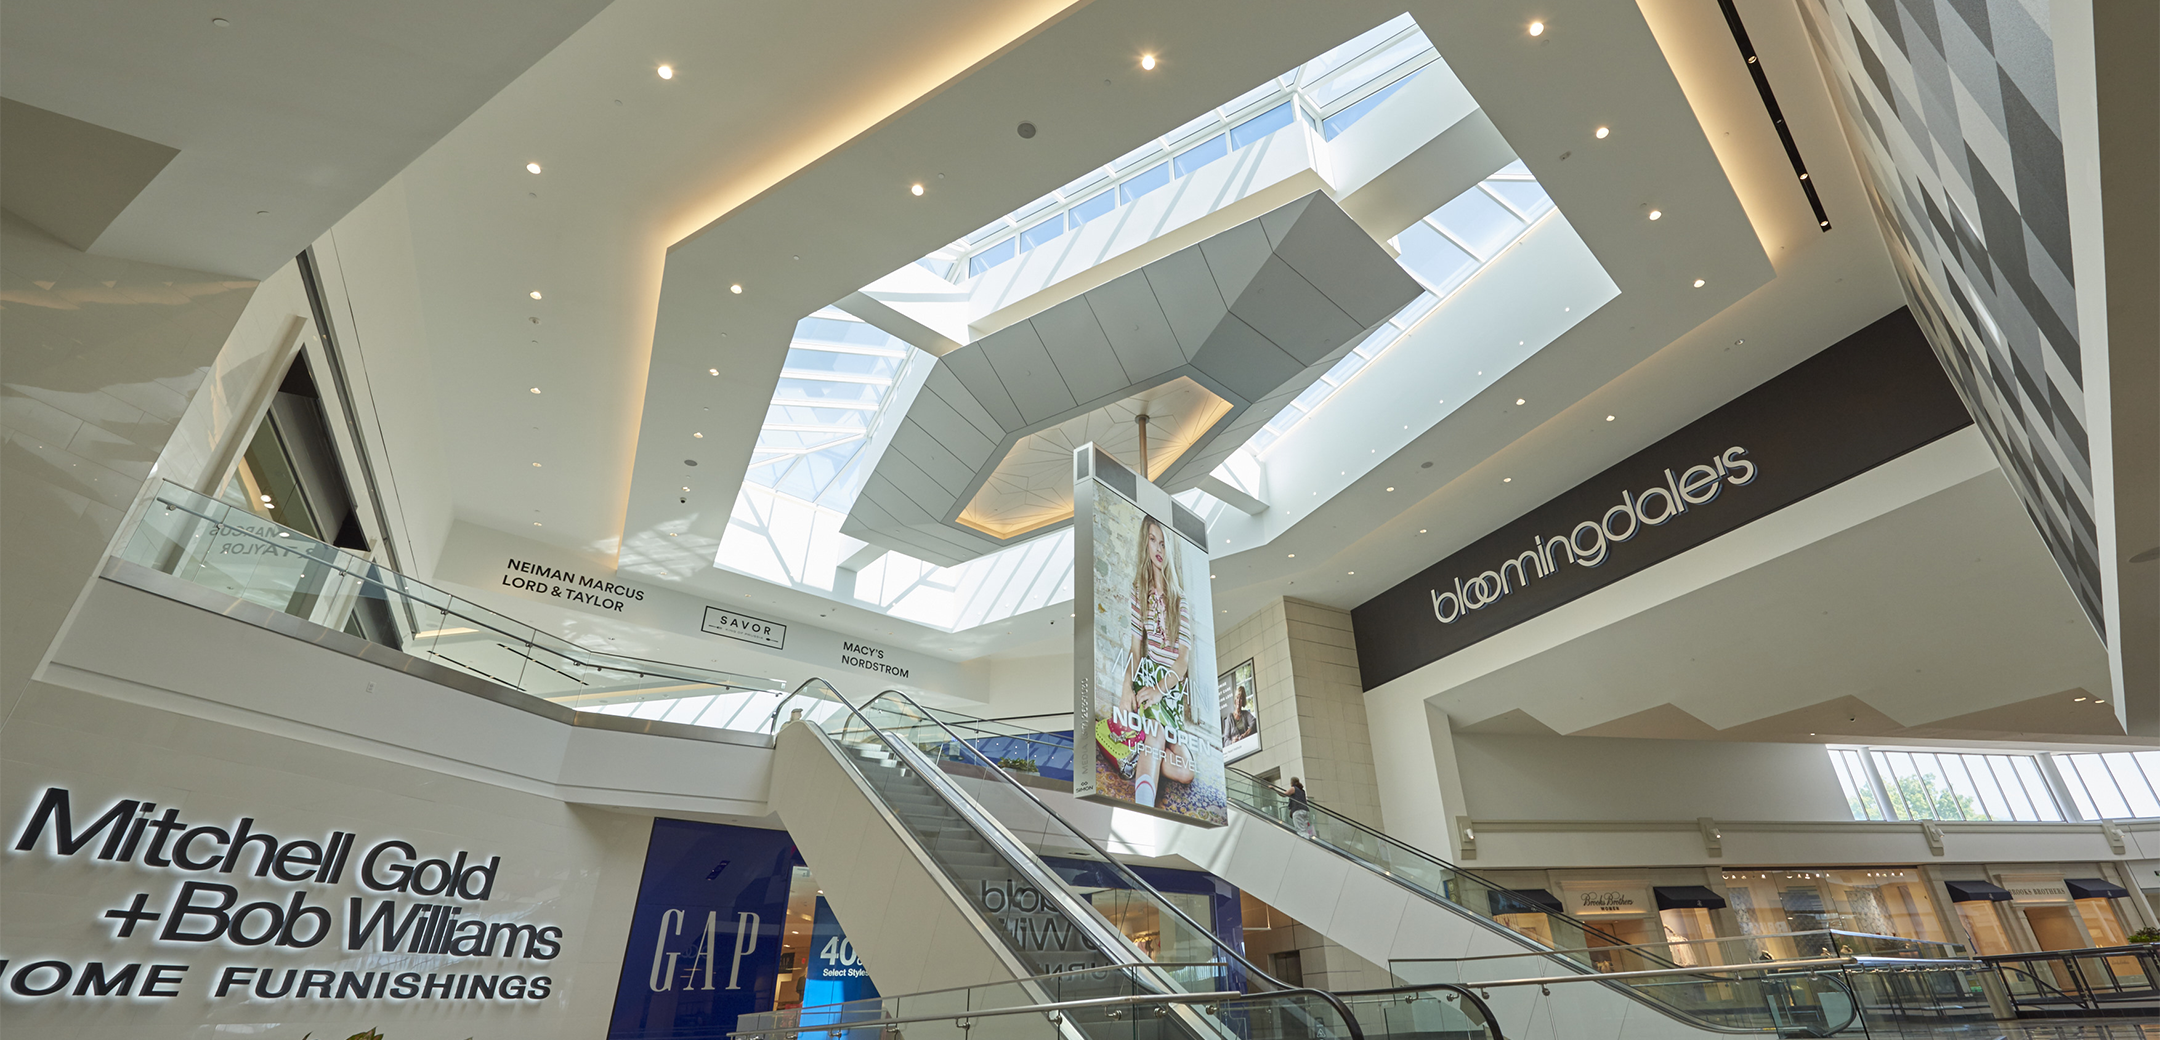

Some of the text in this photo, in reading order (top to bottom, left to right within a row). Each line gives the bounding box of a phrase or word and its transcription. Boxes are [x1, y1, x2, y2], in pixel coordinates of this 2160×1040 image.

[502, 574, 624, 612] LORD & TAYLOR
[507, 558, 645, 601] NEIMAN MARCUS
[720, 616, 771, 635] SAVOR
[841, 654, 909, 679] NORDSTROM
[843, 641, 884, 660] MACY'S
[1113, 705, 1159, 738] NOW
[1164, 725, 1211, 757] OPEN
[1128, 739, 1200, 774] UPPER LEVEL
[1075, 785, 1094, 794] SIMON
[15, 788, 501, 901] Mitchell Gold
[1581, 891, 1634, 906] Brooks Brothers
[347, 897, 564, 961] Williams
[649, 908, 761, 993] GAP
[0, 959, 552, 1000] OME FURNISHINGS
[822, 968, 847, 977] Select
